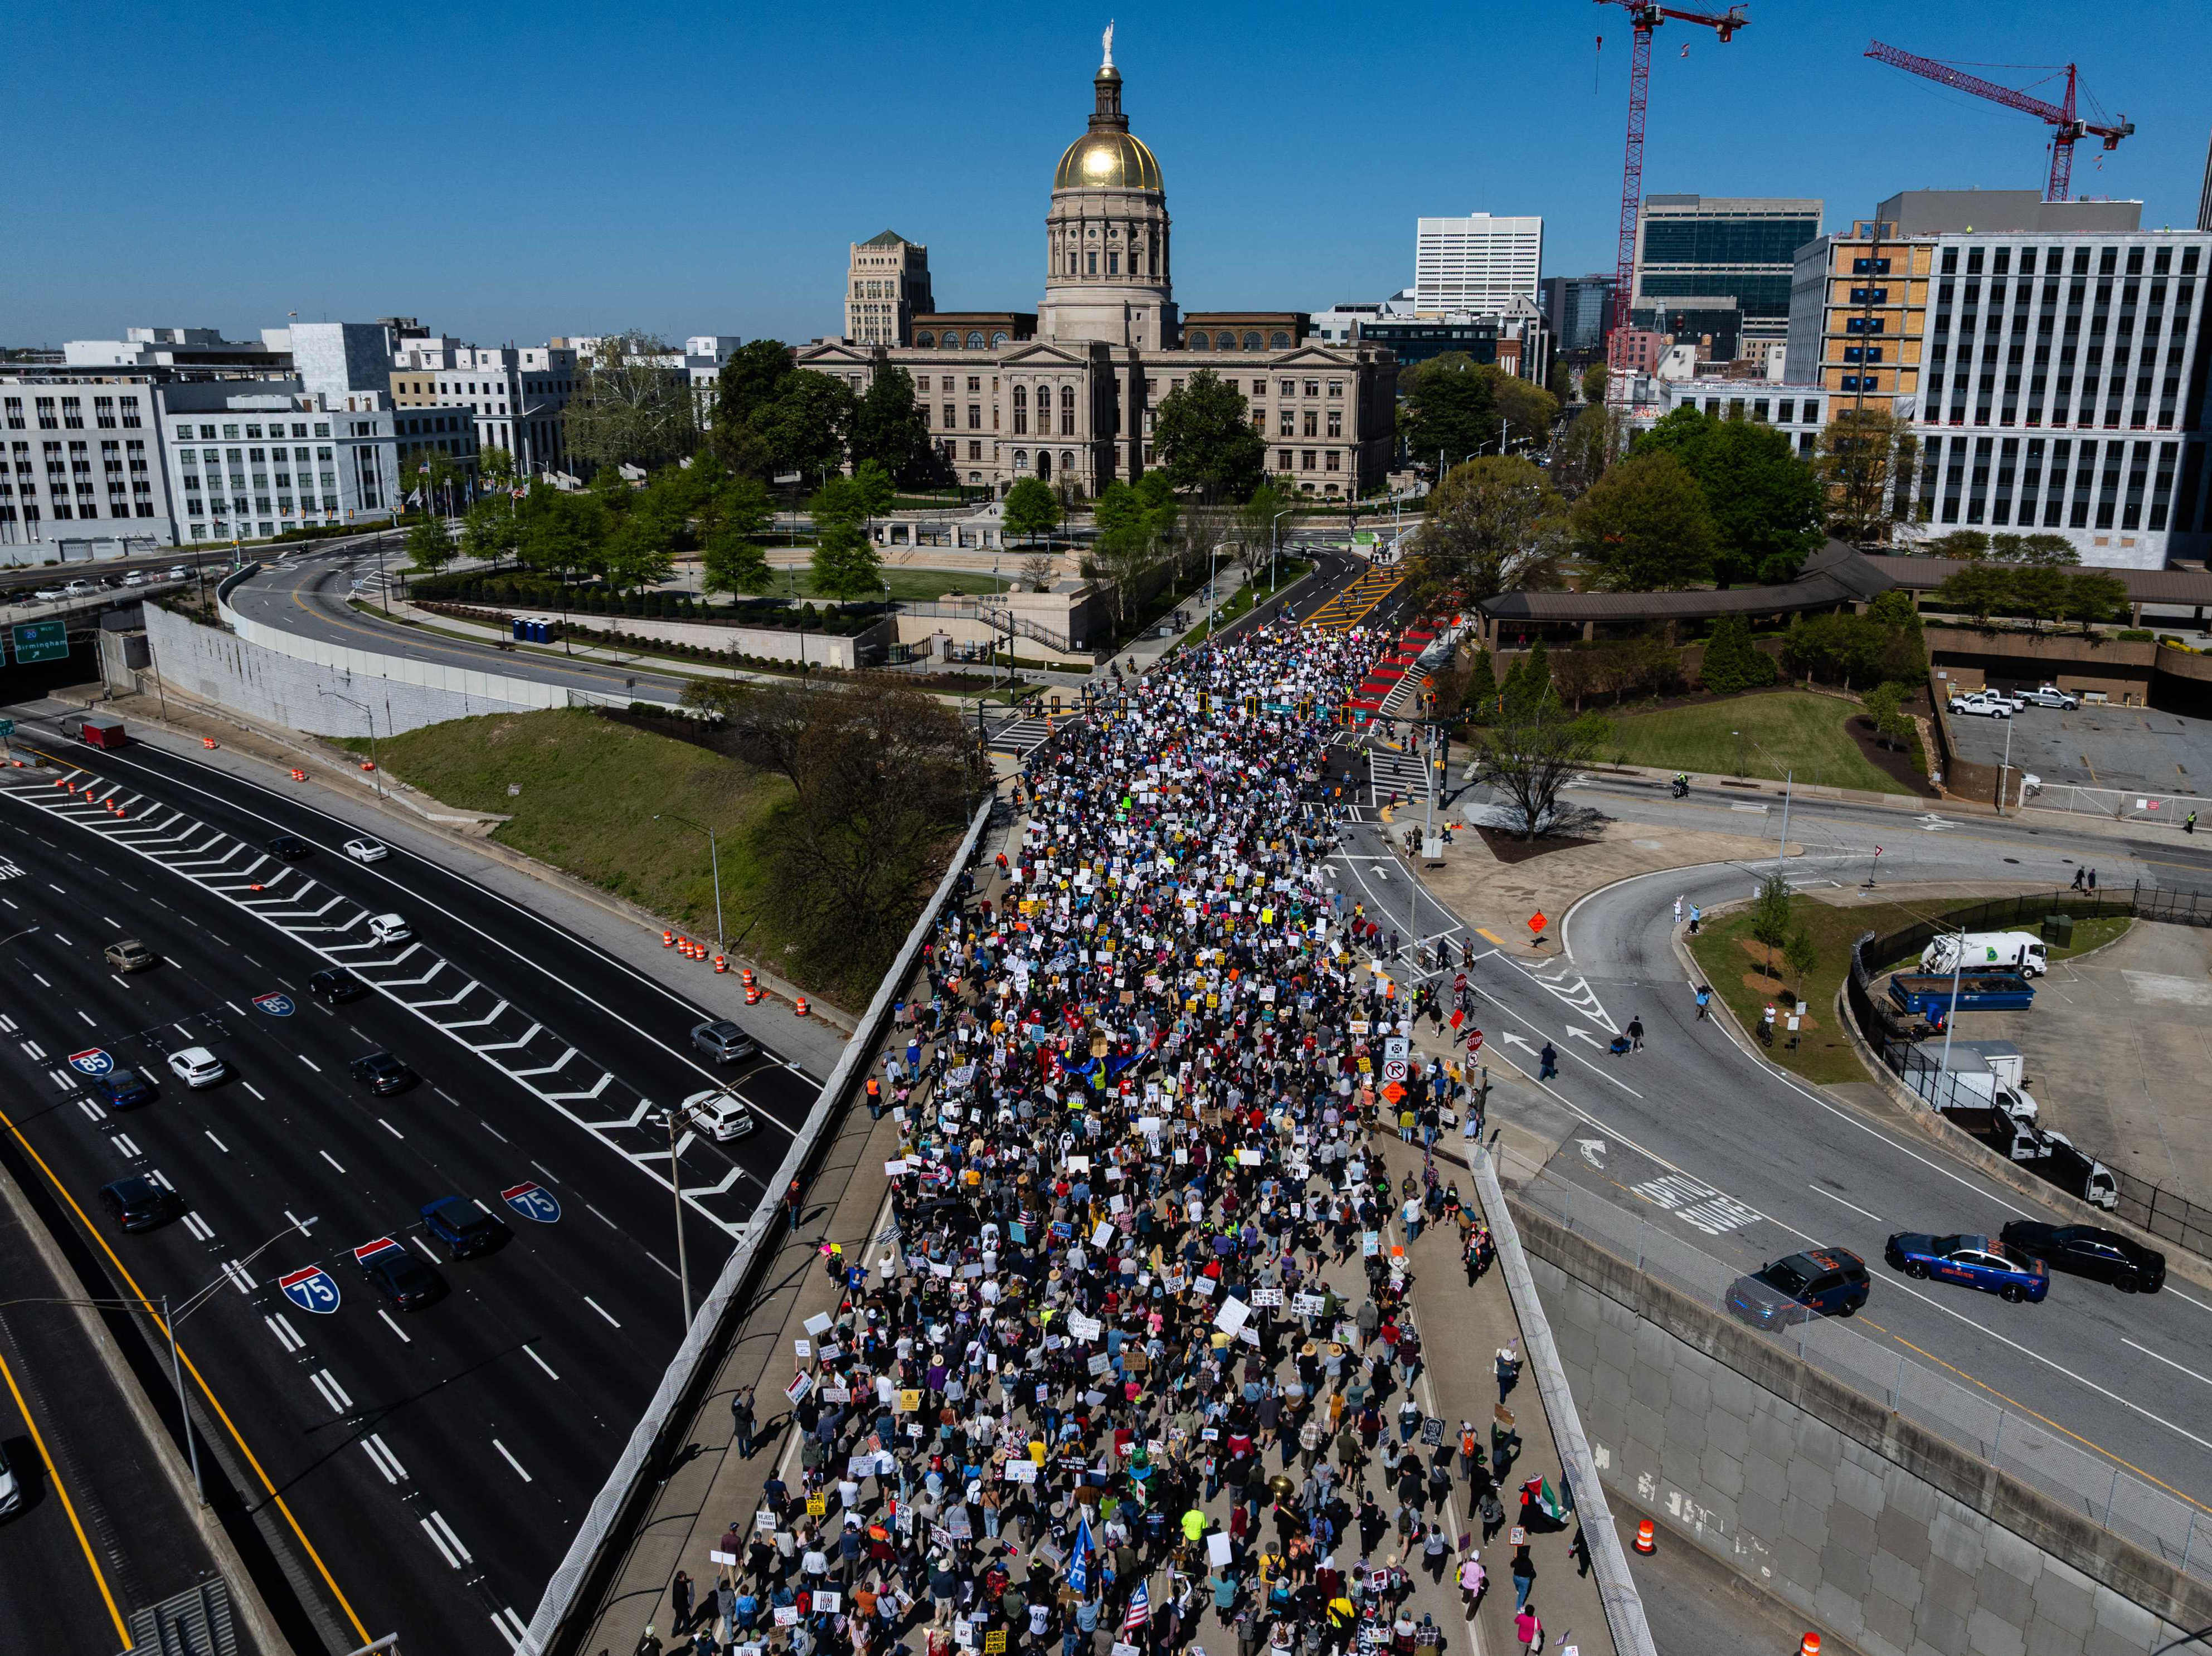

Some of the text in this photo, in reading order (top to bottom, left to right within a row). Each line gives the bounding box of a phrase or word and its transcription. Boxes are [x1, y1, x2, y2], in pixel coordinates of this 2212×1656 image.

[27, 631, 37, 639] 20
[16, 640, 67, 650] Birmingham
[1454, 978, 1467, 988] STOP
[262, 997, 289, 1013] 85
[1468, 1035, 1482, 1046] STOP
[79, 1054, 108, 1071] 85
[1630, 1175, 1717, 1210] CAPITOL
[514, 1191, 555, 1219] 75
[1674, 1197, 1763, 1236] SQUARE
[1168, 1283, 1182, 1292] JOY
[293, 1277, 334, 1310] 75
[1075, 1323, 1098, 1332] HEALTHCARE
[1424, 1434, 1441, 1442] RIGHTS
[930, 1525, 952, 1548] EPSTEIN
[775, 1616, 785, 1625] NO
[1034, 1613, 1044, 1622] 40
